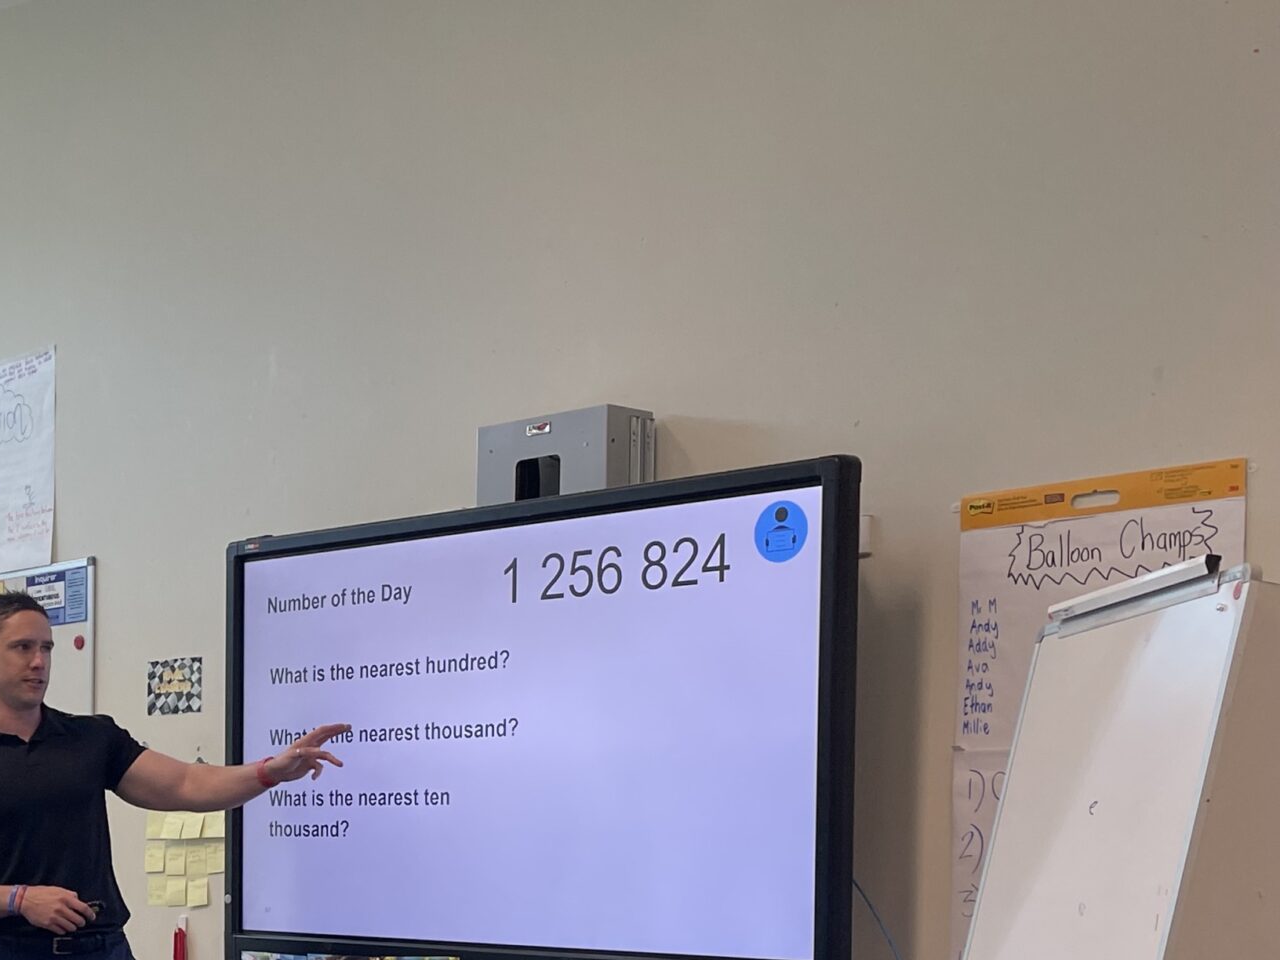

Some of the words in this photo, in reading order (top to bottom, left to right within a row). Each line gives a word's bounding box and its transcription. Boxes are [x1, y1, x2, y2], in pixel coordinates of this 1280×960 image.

[1027, 532, 1102, 571] Balloon
[1120, 517, 1205, 561] Champs
[267, 593, 326, 614] Number
[331, 588, 347, 607] of
[351, 586, 376, 605] the
[381, 583, 412, 605] Day
[504, 557, 518, 604] 1
[540, 545, 623, 600] 256
[641, 532, 731, 590] 824
[970, 619, 999, 639] Andy
[968, 638, 997, 659] Addy
[270, 666, 308, 685] What
[312, 665, 325, 682] is
[330, 663, 355, 681] the
[360, 657, 421, 679] nearest
[426, 649, 510, 674] hundred?
[967, 660, 990, 677] Ava
[965, 679, 994, 697] Andy
[963, 695, 993, 715] Ethan
[359, 725, 420, 743] nearest
[424, 717, 519, 739] thousand?
[962, 718, 990, 735] Millie
[270, 789, 307, 807] What
[312, 789, 325, 807] is
[329, 789, 354, 807] the
[359, 789, 419, 807] nearest
[424, 788, 450, 806] ten
[968, 769, 985, 813] 1)
[269, 819, 350, 838] thousand?
[959, 823, 984, 875] 2)
[958, 883, 979, 918] 3
